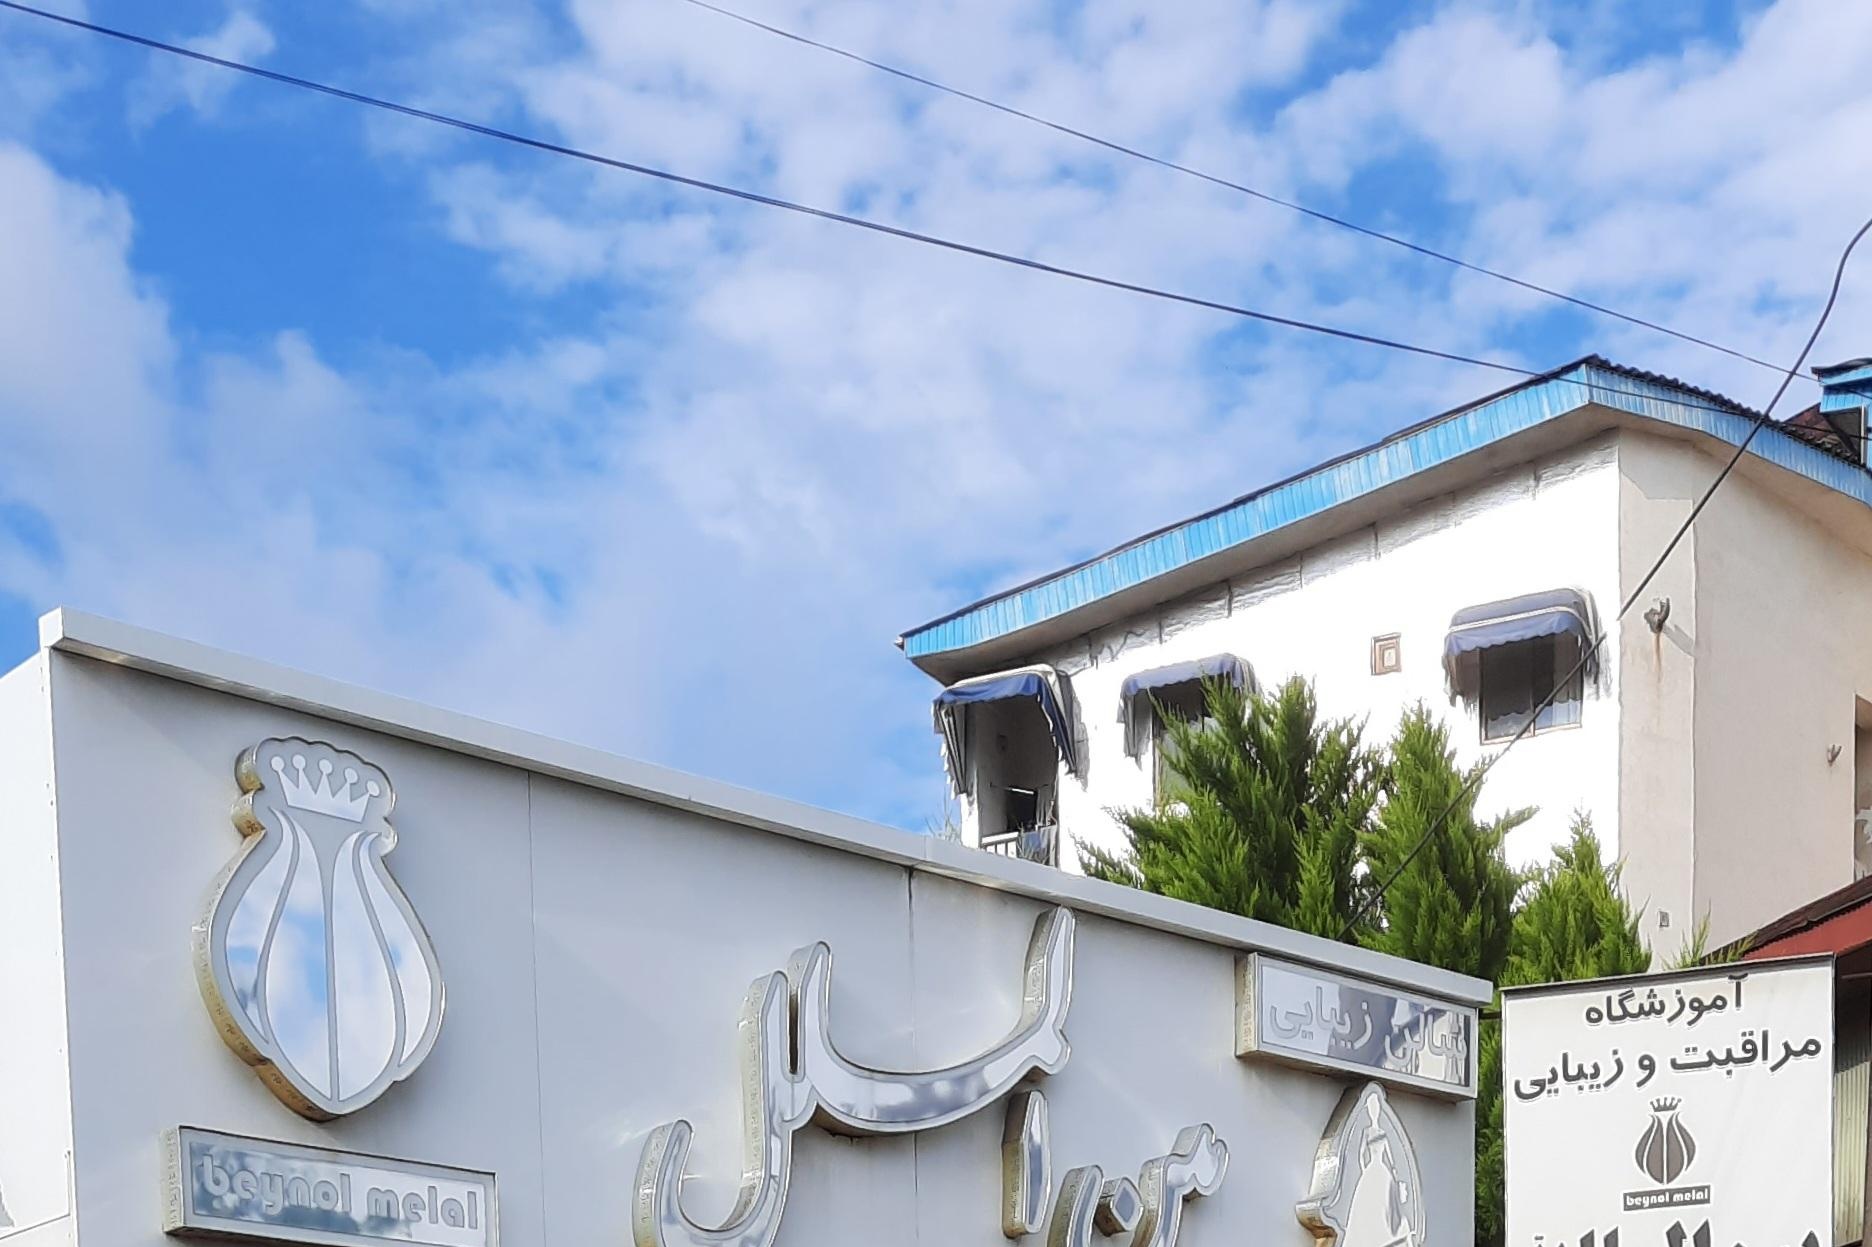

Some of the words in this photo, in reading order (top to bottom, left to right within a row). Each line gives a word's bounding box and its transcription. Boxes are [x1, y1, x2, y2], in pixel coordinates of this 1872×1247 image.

[1269, 985, 1373, 1051] زیبایی
[1585, 972, 1749, 1027] آموزشگاه
[1514, 1048, 1625, 1100] زیبایی
[1636, 1051, 1657, 1088] و
[1670, 1029, 1822, 1079] مراقبت
[366, 1185, 479, 1230] melal
